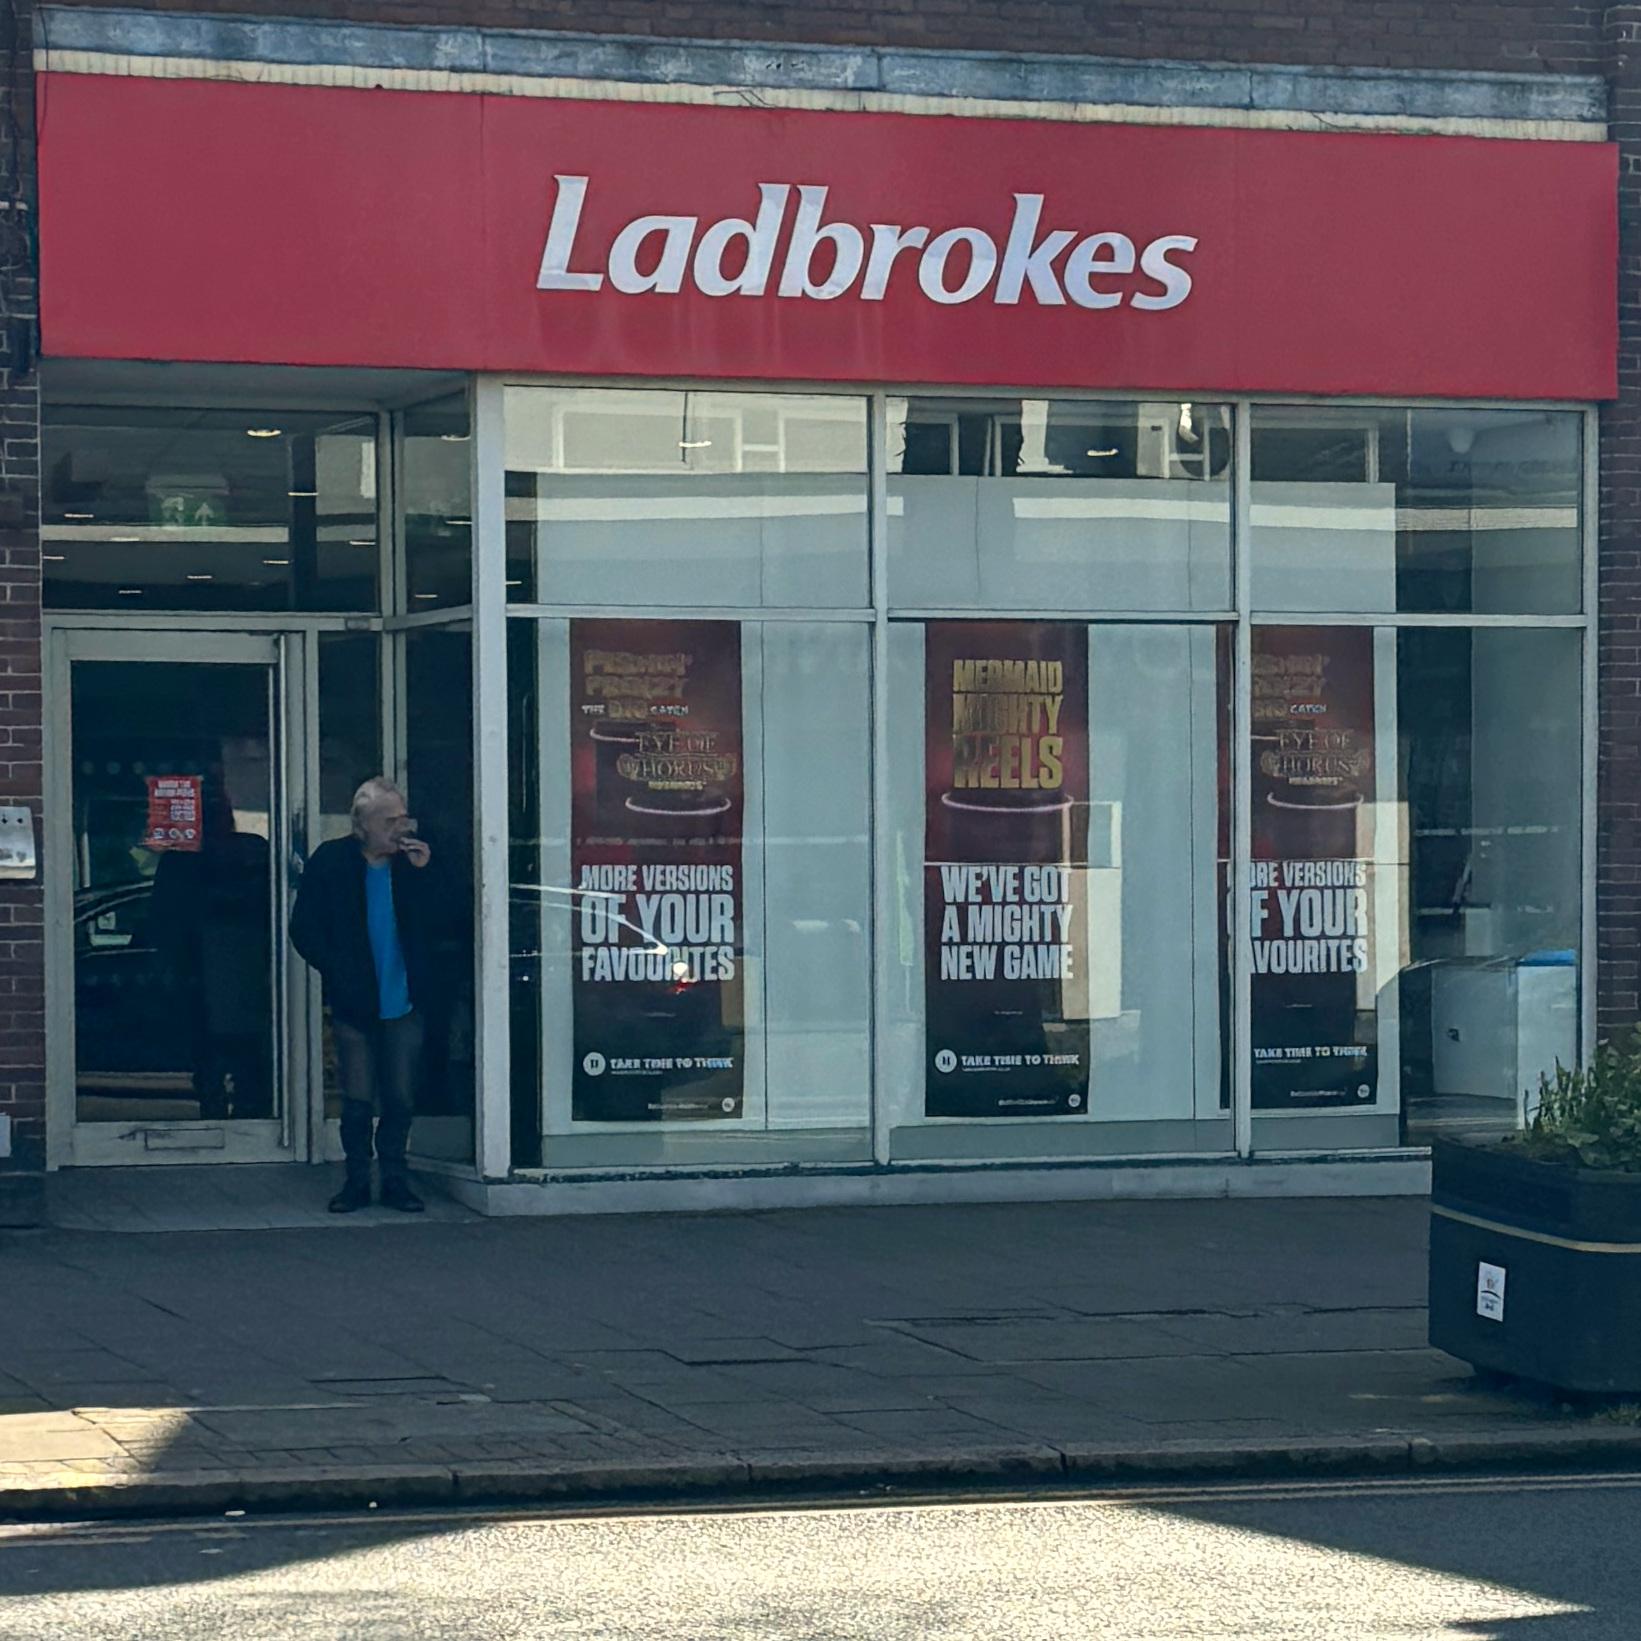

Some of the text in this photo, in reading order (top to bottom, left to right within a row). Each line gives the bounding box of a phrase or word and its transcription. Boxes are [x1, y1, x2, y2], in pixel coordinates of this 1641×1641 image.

[537, 175, 1197, 309] Ladbrokes
[580, 865, 734, 891] MORE VERSIONS
[940, 866, 1072, 903] WE'VE GOT
[1282, 861, 1366, 887] VERSIONS
[580, 894, 735, 943] OF YOUR
[941, 904, 1073, 942] A MIGHTY
[1277, 889, 1368, 937] YOUR
[582, 946, 735, 981] FAVOURITES
[941, 944, 1073, 980] NEW GAME
[1024, 1055, 1041, 1065] TO
